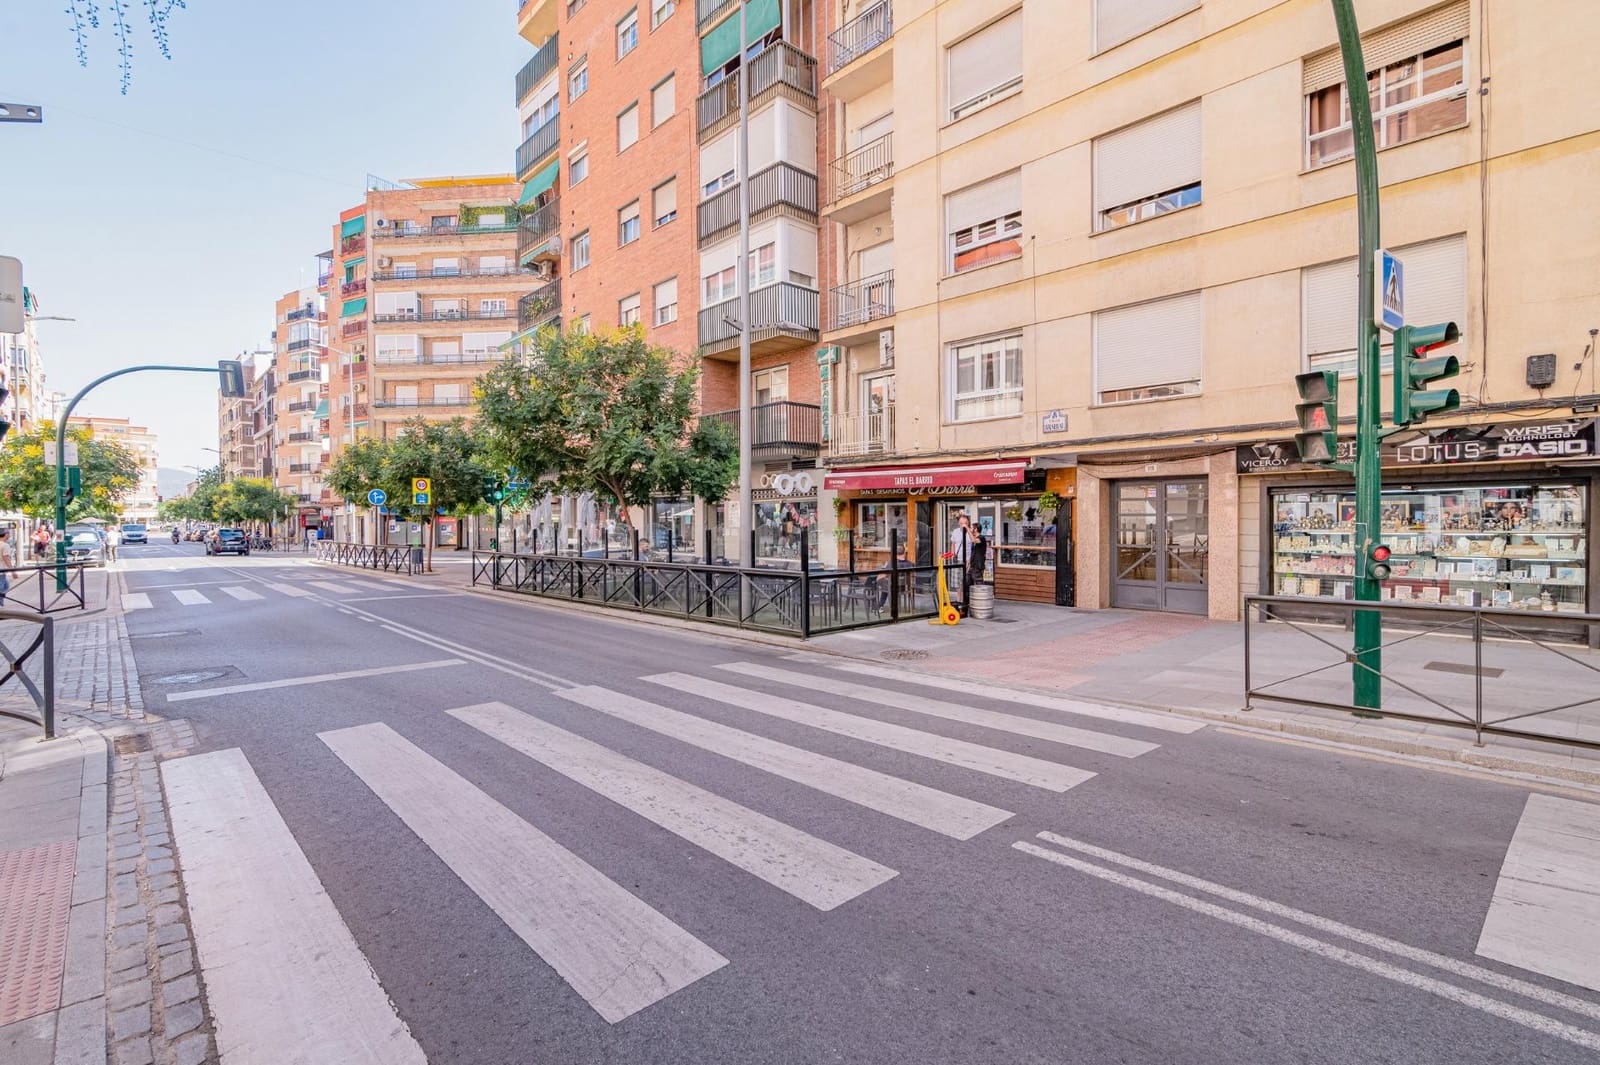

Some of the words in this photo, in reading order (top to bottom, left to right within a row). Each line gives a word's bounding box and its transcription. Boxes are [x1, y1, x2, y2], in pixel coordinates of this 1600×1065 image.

[1504, 423, 1580, 435] WRIST
[1502, 431, 1577, 442] TECHNOLOGY
[1397, 442, 1480, 462] LOTUS
[1498, 439, 1587, 457] CASIO
[1241, 458, 1289, 468] VICEROY
[894, 477, 908, 485] TAPAS
[916, 476, 933, 484] BARRIO
